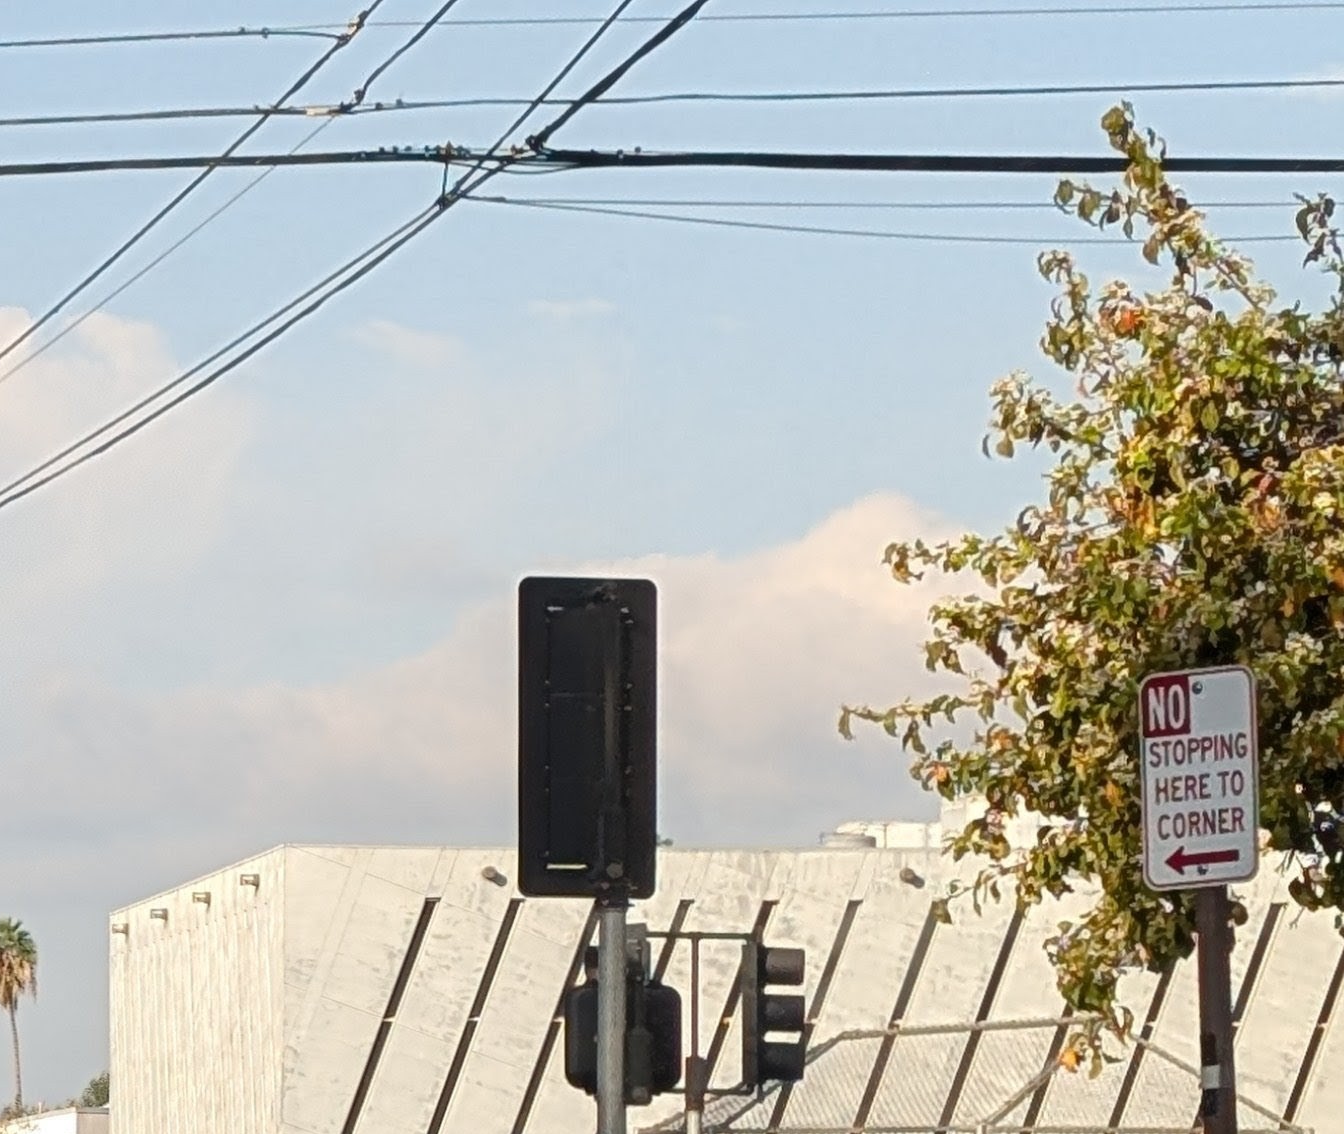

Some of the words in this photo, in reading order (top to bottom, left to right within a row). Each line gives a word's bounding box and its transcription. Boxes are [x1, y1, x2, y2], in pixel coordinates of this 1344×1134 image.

[1148, 684, 1186, 732] NO
[1149, 733, 1247, 768] STOPPING
[1155, 774, 1211, 805] HERE
[1217, 770, 1244, 798] TO
[1158, 807, 1245, 840] CORNER
